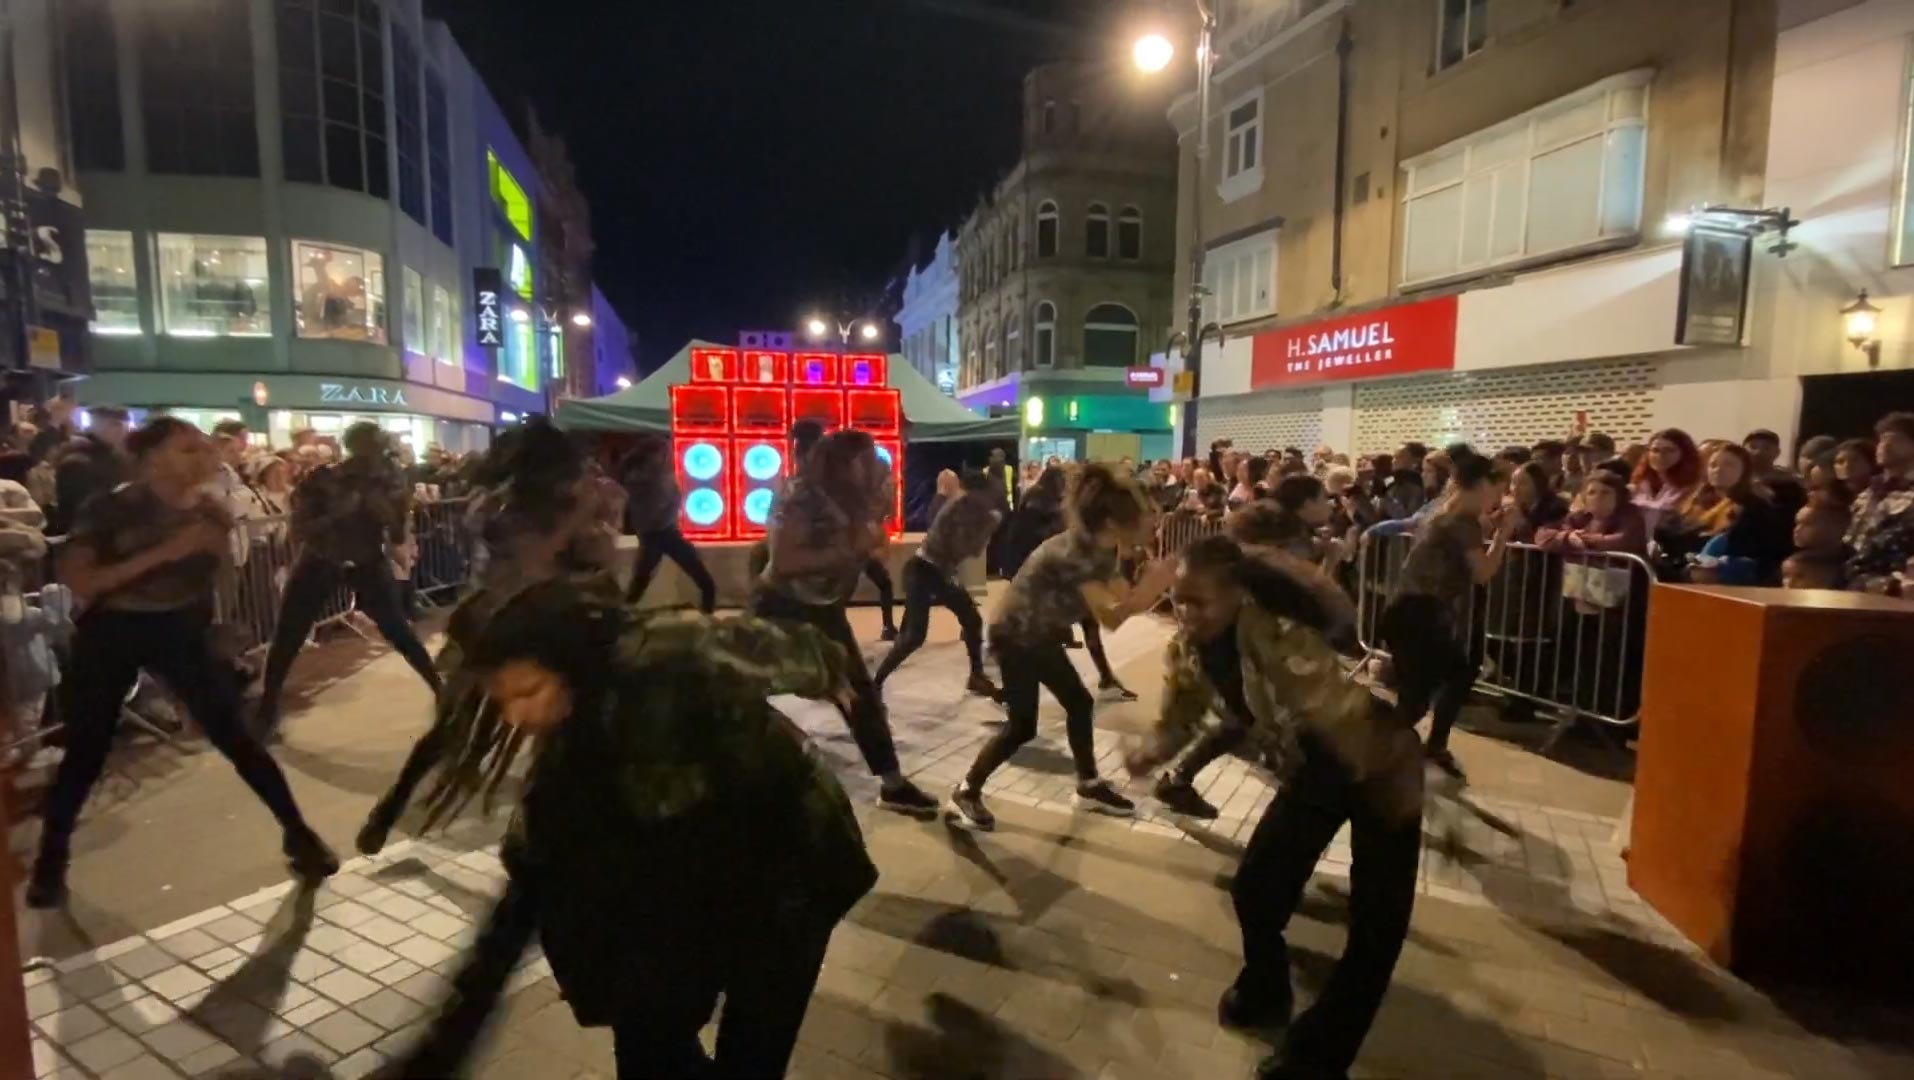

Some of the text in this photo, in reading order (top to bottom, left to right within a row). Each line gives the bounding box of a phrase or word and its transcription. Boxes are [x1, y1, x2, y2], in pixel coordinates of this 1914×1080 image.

[479, 291, 498, 344] ZARA
[1287, 349, 1392, 373] THE JEWELLER
[320, 383, 408, 406] ZARA
